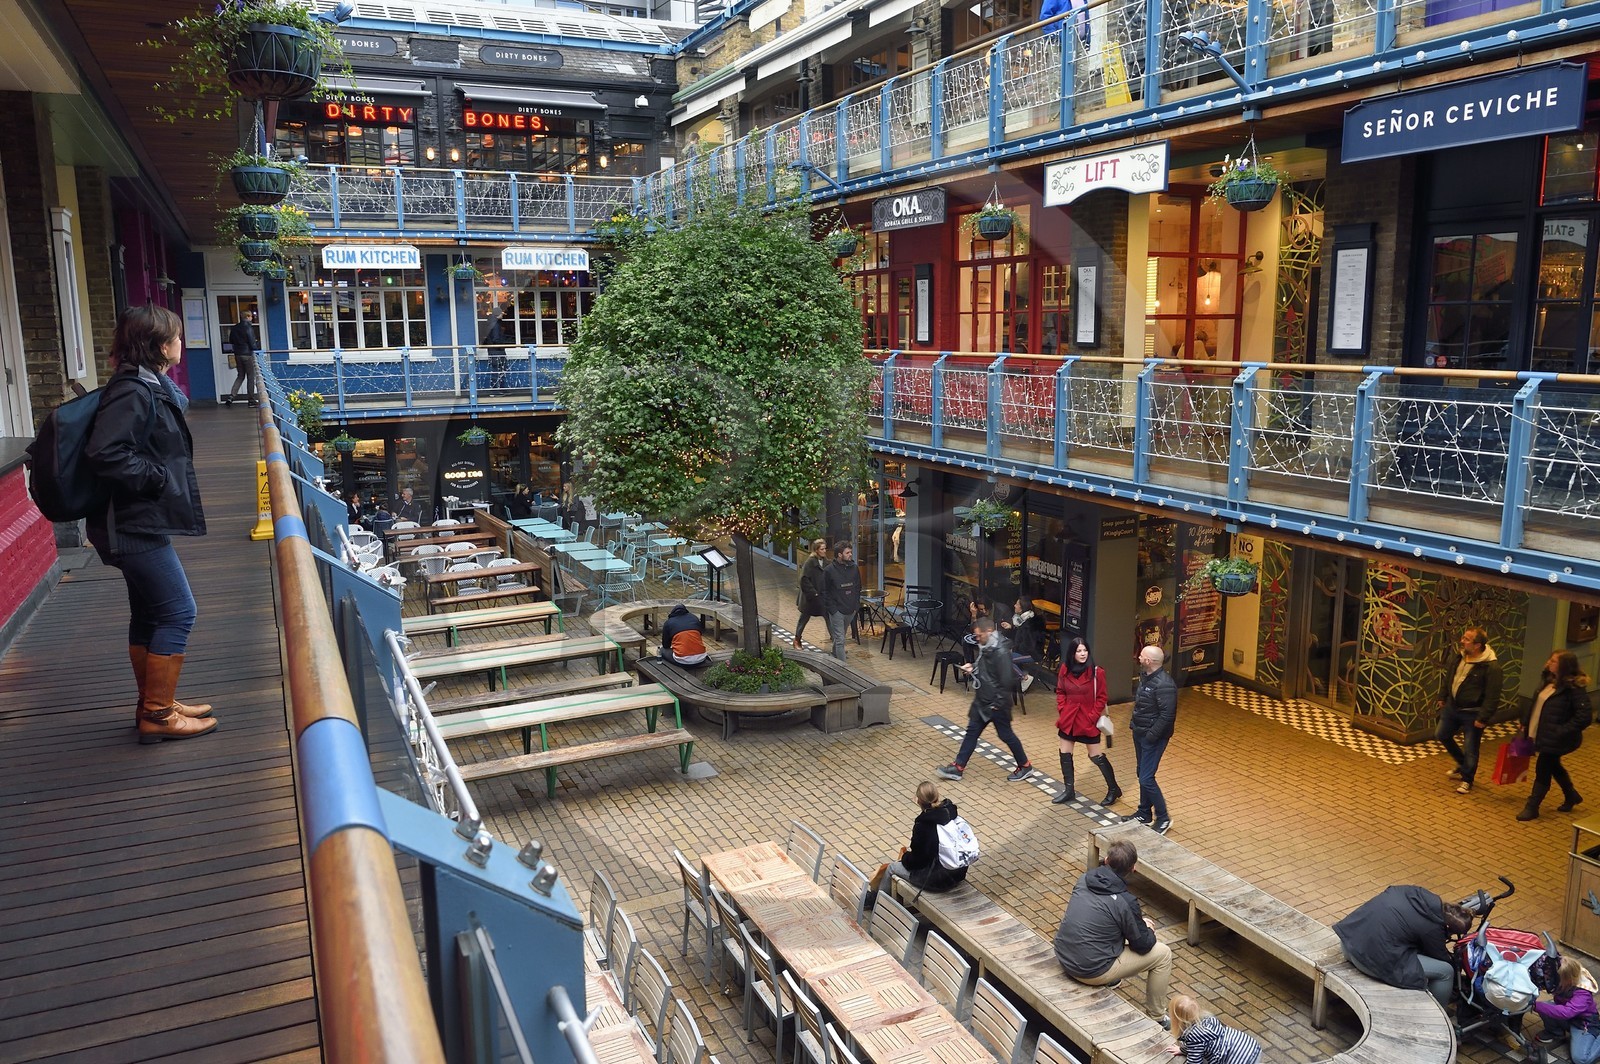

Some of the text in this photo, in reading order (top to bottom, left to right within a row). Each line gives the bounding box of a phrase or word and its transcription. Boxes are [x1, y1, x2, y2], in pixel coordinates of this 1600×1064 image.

[351, 40, 380, 49] BONES
[495, 51, 548, 62] DIRTY BONES
[327, 103, 412, 121] DIRTY
[518, 106, 562, 116] DIRTY BONES
[1362, 86, 1559, 139] SEÑOR CEVICHE
[465, 112, 541, 129] BONES
[1085, 157, 1120, 183] LIFT
[325, 249, 417, 264] RUM KITCHEN
[504, 252, 586, 266] RUM KITCHEN
[444, 470, 483, 479] GOOD EGG
[1188, 525, 1222, 537] 10 Benefits
[1193, 537, 1201, 547] of
[1238, 540, 1254, 552] NO
